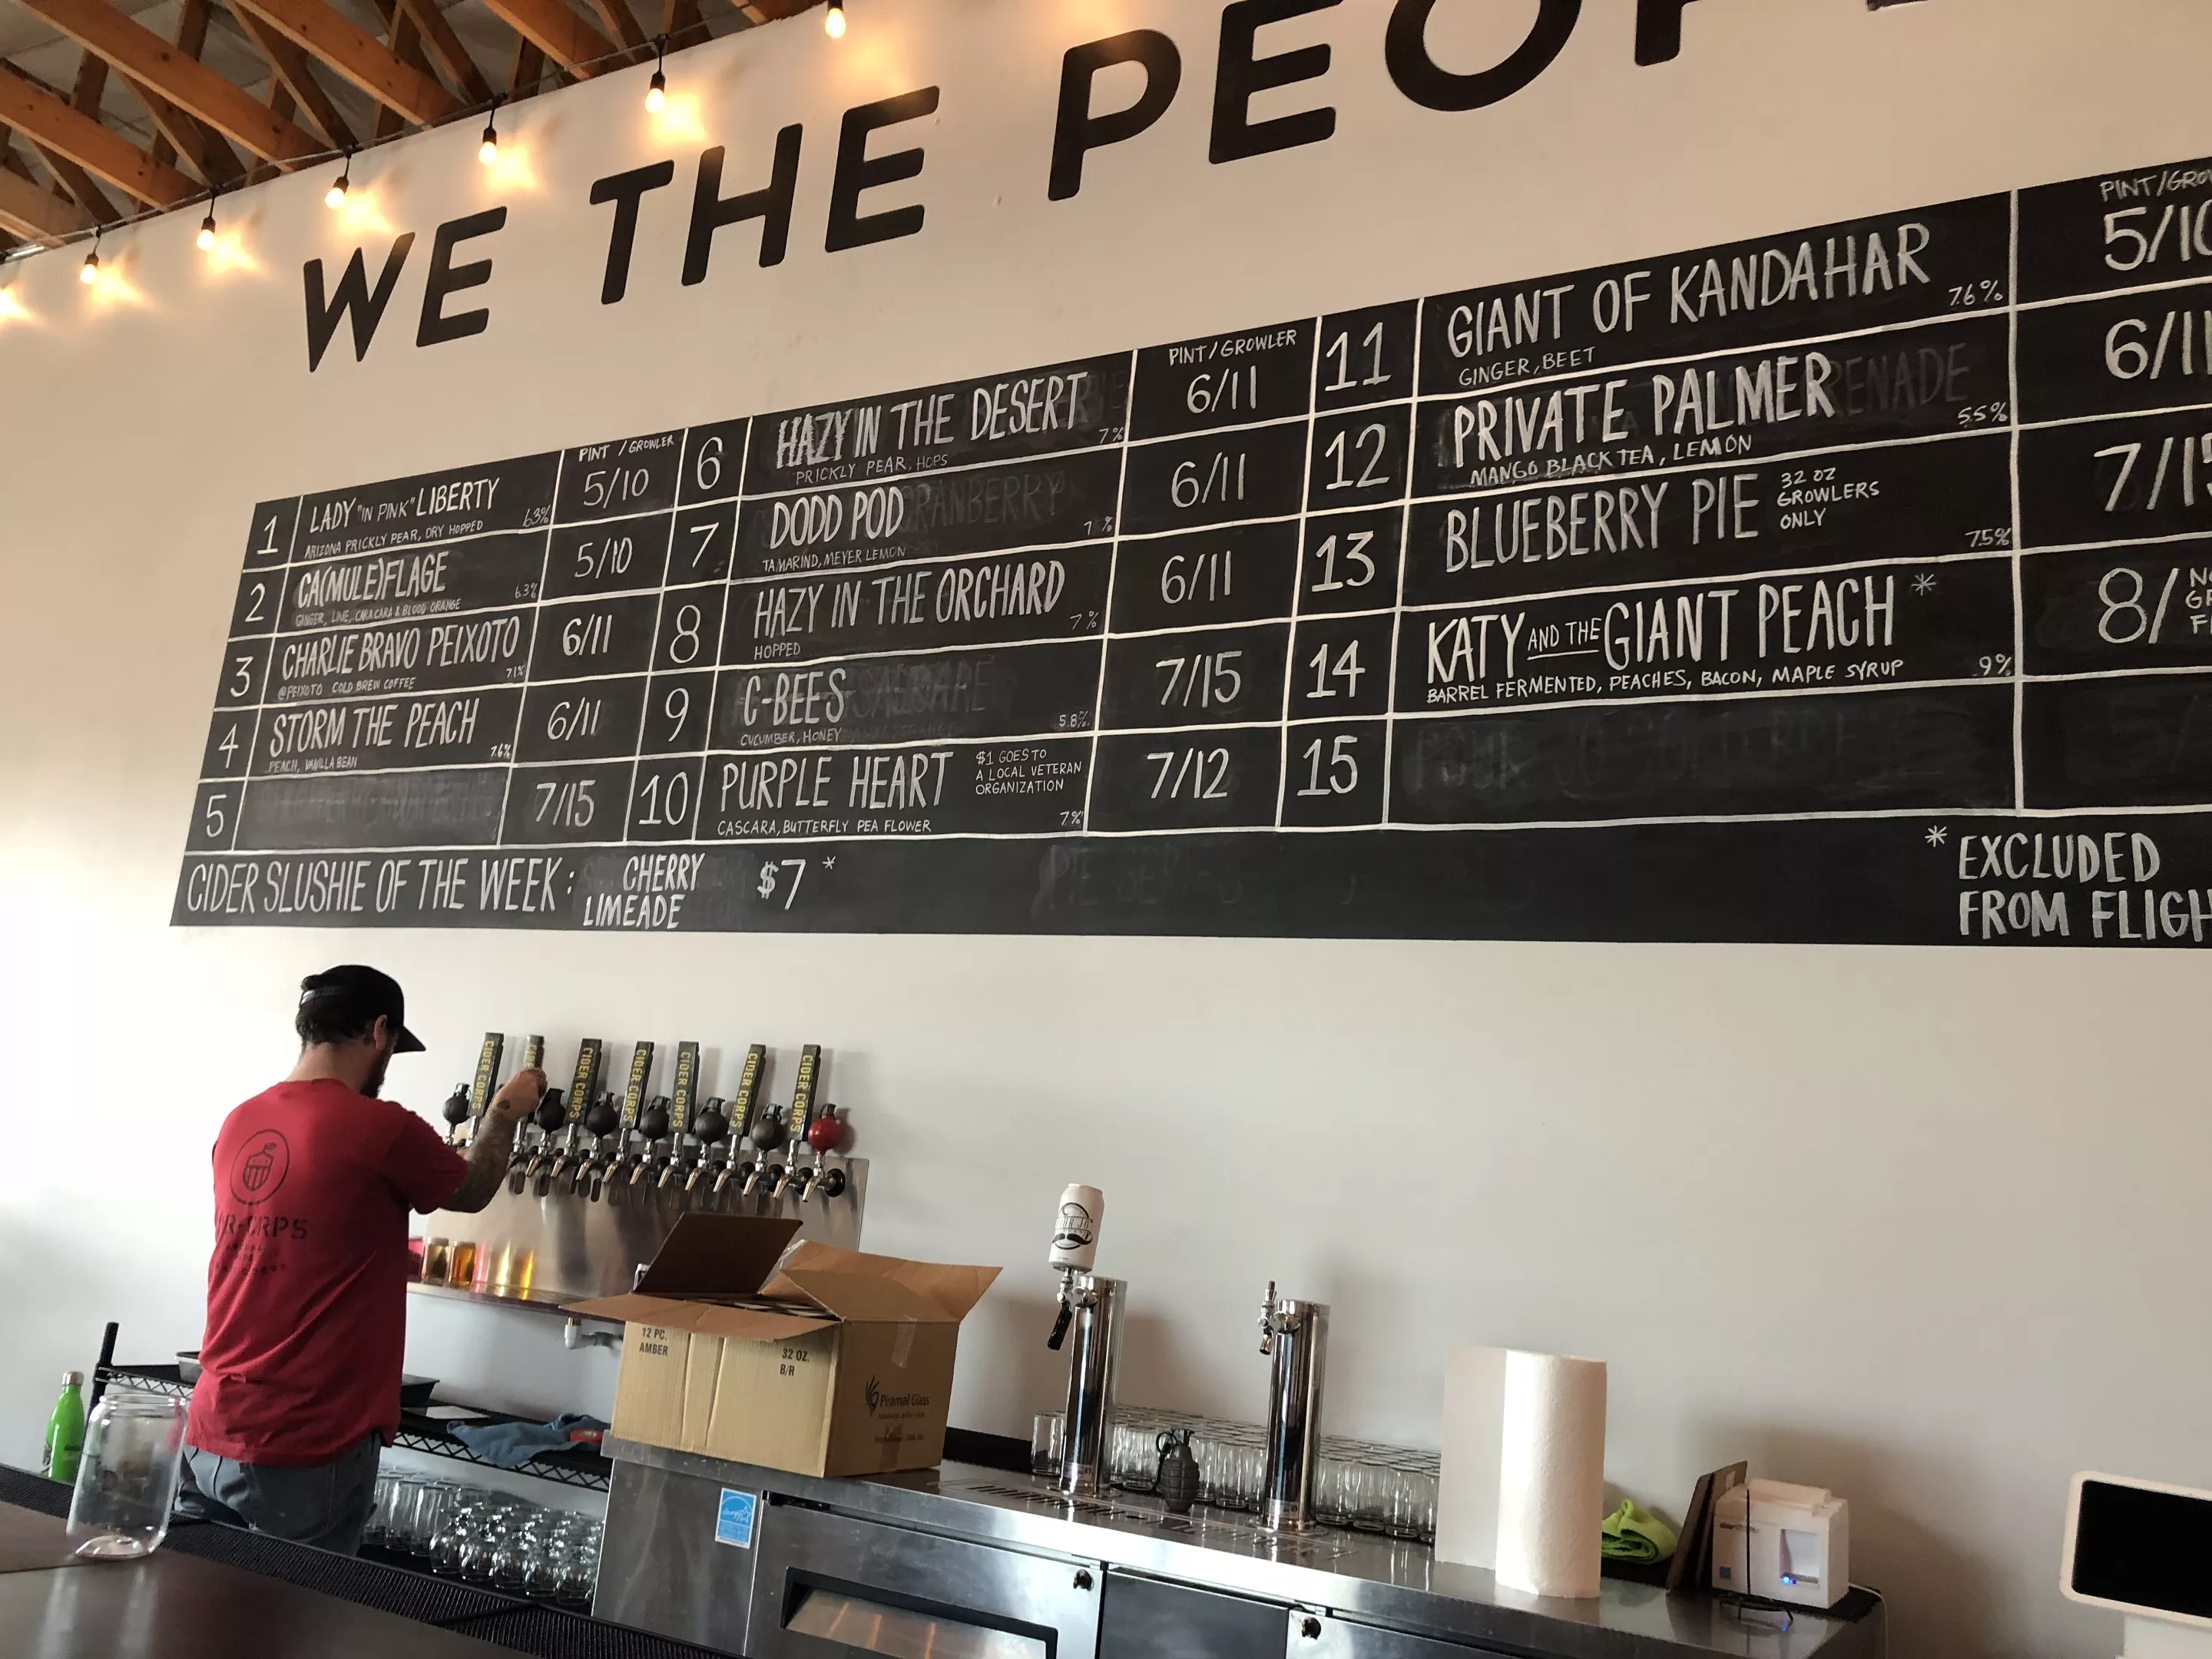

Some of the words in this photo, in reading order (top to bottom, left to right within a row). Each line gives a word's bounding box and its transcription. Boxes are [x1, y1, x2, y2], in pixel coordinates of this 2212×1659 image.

[303, 206, 507, 373] WE
[589, 85, 940, 305] THE
[1048, 0, 1929, 201] PEO
[1325, 322, 1392, 392] 11
[1447, 284, 1575, 358] GIANT
[1593, 270, 1651, 333] OF
[1671, 222, 1930, 323] KANDAHAR
[1542, 346, 1595, 369] BEET
[697, 436, 724, 489] 6
[776, 408, 854, 469] HAZY
[854, 405, 882, 458] IN
[890, 394, 955, 450] THE
[971, 371, 1088, 441] DESERT
[1186, 365, 1257, 413] 6/11
[1326, 423, 1389, 490] 12
[1455, 379, 1628, 469] PRIVATE
[1653, 352, 1835, 435] PALMER
[579, 445, 610, 462] PINT
[796, 463, 856, 485] PRICKLY
[866, 456, 912, 476] PEAR,
[916, 454, 949, 471] HOPS
[1470, 461, 1539, 486] MANGO
[1547, 451, 1614, 477] BLACK
[1674, 434, 1752, 460] LEMON
[257, 515, 279, 555] 1
[310, 498, 356, 533] LADY
[416, 478, 499, 516] LIBERTY
[583, 468, 649, 508] 5/10
[690, 522, 720, 568] 7
[770, 495, 843, 550] DODD
[850, 486, 905, 541] POD
[1171, 452, 1246, 508] 6/11
[1777, 481, 1879, 507] GROWLERS
[1311, 531, 1376, 592] 13
[1446, 482, 1668, 573] BLUEBERRY
[1693, 474, 1760, 545] PIE
[1781, 470, 1806, 488] 32
[1813, 467, 1836, 482] OZ
[1780, 508, 1826, 530] ONLY
[305, 541, 341, 558] ARIZONA
[346, 536, 386, 553] PRICKLY
[391, 529, 422, 544] PEAR,
[426, 525, 444, 539] DRY
[449, 520, 483, 535] HOPPED
[824, 550, 863, 569] MEYER
[866, 546, 906, 565] LEMON
[245, 583, 266, 622] 2
[297, 550, 449, 608] CA(MULE)FLAGE
[575, 537, 633, 579] 5/10
[295, 614, 328, 628] GINGER,
[402, 604, 426, 616] BLOOD
[430, 598, 462, 612] ORANGE
[670, 604, 701, 663] 8
[753, 584, 825, 641] HAZY
[830, 581, 862, 628] IN
[871, 571, 932, 626] THE
[935, 560, 1066, 624] ORCHARD
[1161, 551, 1231, 604] 6/11
[754, 643, 801, 661] HOPPED
[1306, 640, 1366, 699] 14
[1428, 612, 1525, 684] KATY
[1528, 624, 1559, 652] AND
[1565, 617, 1601, 645] THE
[1604, 589, 1739, 671] GIANT
[1759, 575, 1894, 657] PEACH
[230, 657, 254, 697] 3
[282, 633, 359, 680] CHARLIE
[359, 628, 420, 672] BRAVO
[427, 616, 519, 667] PEIXOTO
[562, 614, 613, 656] 6/11
[278, 683, 323, 700] @PEIXOTO
[333, 680, 354, 693] COLD
[356, 678, 380, 691] BREW
[384, 677, 416, 690] COFFEE
[665, 687, 689, 742] 9
[743, 668, 846, 727] C-BEES
[1155, 651, 1242, 708] 7/15
[1427, 684, 1489, 704] BARREL
[1497, 675, 1603, 699] FERMENTED,
[1609, 670, 1692, 691] PEACHES,
[1701, 669, 1763, 688] BACON,
[1772, 664, 1836, 684] MAPLE
[1845, 659, 1904, 680] SYRUP
[218, 724, 240, 768] 4
[269, 707, 346, 758] STORM
[352, 704, 399, 749] THE
[403, 697, 480, 748] PEACH
[547, 697, 601, 741] 6/11
[740, 730, 800, 747] CUCUMBER,
[803, 727, 843, 743] HONEY
[268, 759, 300, 773] PEACH,
[305, 756, 334, 771] VANILLA
[336, 756, 358, 768] BEAN
[975, 770, 983, 781] A
[988, 766, 1025, 781] LOCAL
[1031, 760, 1082, 777] VETERAN
[976, 750, 995, 766] $1
[998, 748, 1029, 763] GOES
[1031, 749, 1047, 761] TO
[1297, 734, 1359, 796] 15
[638, 771, 689, 826] 10
[720, 756, 832, 812] PURPLE
[849, 751, 954, 810] HEART
[1147, 748, 1230, 799] 7/12
[975, 778, 1064, 795] ORGANIZATION
[206, 794, 228, 838] 5
[535, 780, 596, 827] 7/15
[717, 821, 780, 836] CASCARA,
[783, 819, 849, 834] BUTTERFLY
[857, 820, 879, 833] PEA
[885, 819, 932, 833] FLOWER
[1959, 832, 2161, 883] EXCLUDED
[187, 862, 260, 914] CIDER
[263, 859, 371, 913] SLUSHIE
[376, 859, 412, 913] OF
[418, 857, 469, 910] THE
[622, 853, 706, 892] CHERRY
[757, 859, 806, 910] $7
[583, 893, 685, 929] LIMEADE
[1959, 889, 2071, 939] FROM
[481, 1041, 494, 1071] CIDER
[578, 1048, 593, 1078] CIDER
[632, 1049, 646, 1081] CIDER
[677, 1051, 690, 1085] CIDER
[741, 1053, 758, 1086] CIDER
[798, 1055, 813, 1089] CIDER
[472, 1075, 486, 1110] CORPS
[569, 1082, 586, 1118] CORPS
[623, 1085, 639, 1122] CORPS
[673, 1090, 687, 1128] CORPS
[731, 1090, 749, 1128] CORPS
[790, 1093, 806, 1132] CORPS
[639, 1343, 668, 1356] AMBER
[642, 1327, 651, 1338] 12
[654, 1329, 667, 1340] PC.
[780, 1364, 795, 1376] B/R
[782, 1348, 793, 1359] 32
[796, 1350, 810, 1363] OZ.
[879, 1393, 909, 1407] Piramal
[911, 1394, 930, 1407] Glass
